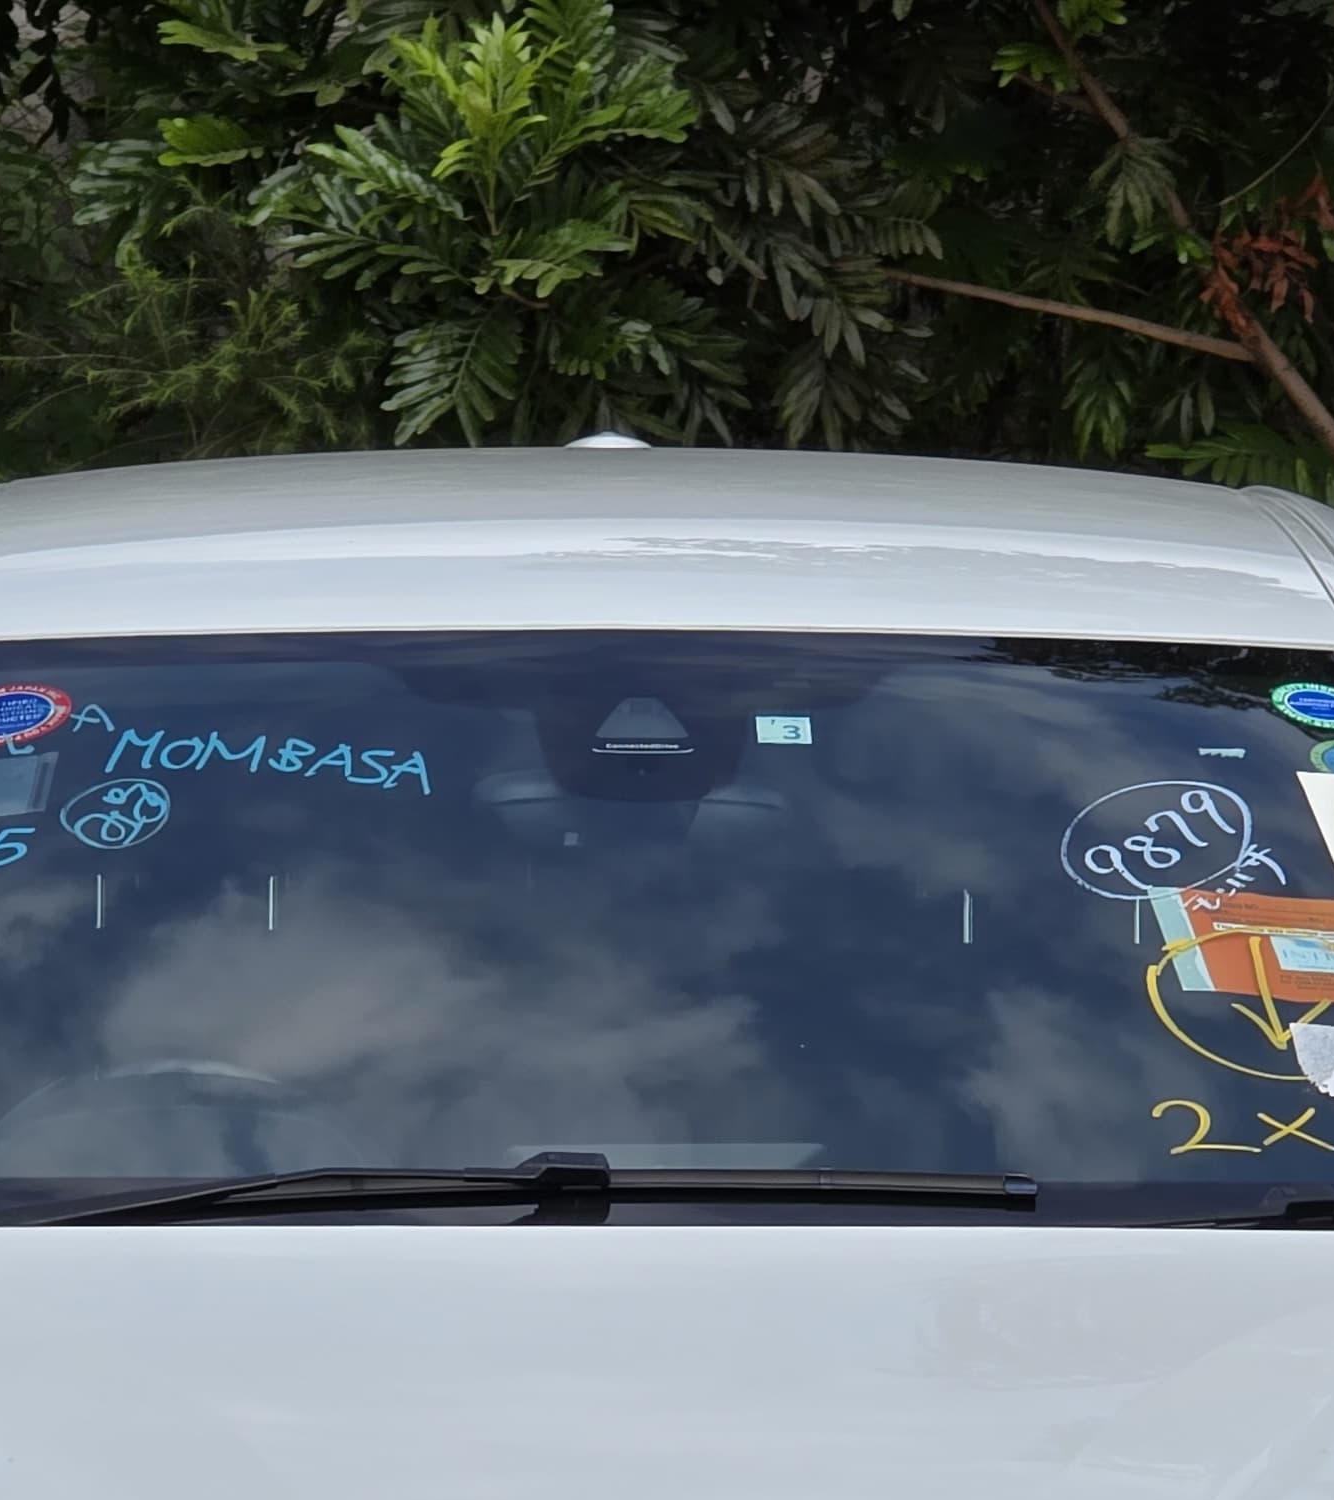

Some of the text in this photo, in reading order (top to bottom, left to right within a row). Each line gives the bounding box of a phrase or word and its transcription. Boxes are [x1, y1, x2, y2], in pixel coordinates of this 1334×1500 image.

[104, 728, 432, 796] MOMBASA
[782, 725, 801, 740] 3
[1084, 789, 1237, 891] 9879
